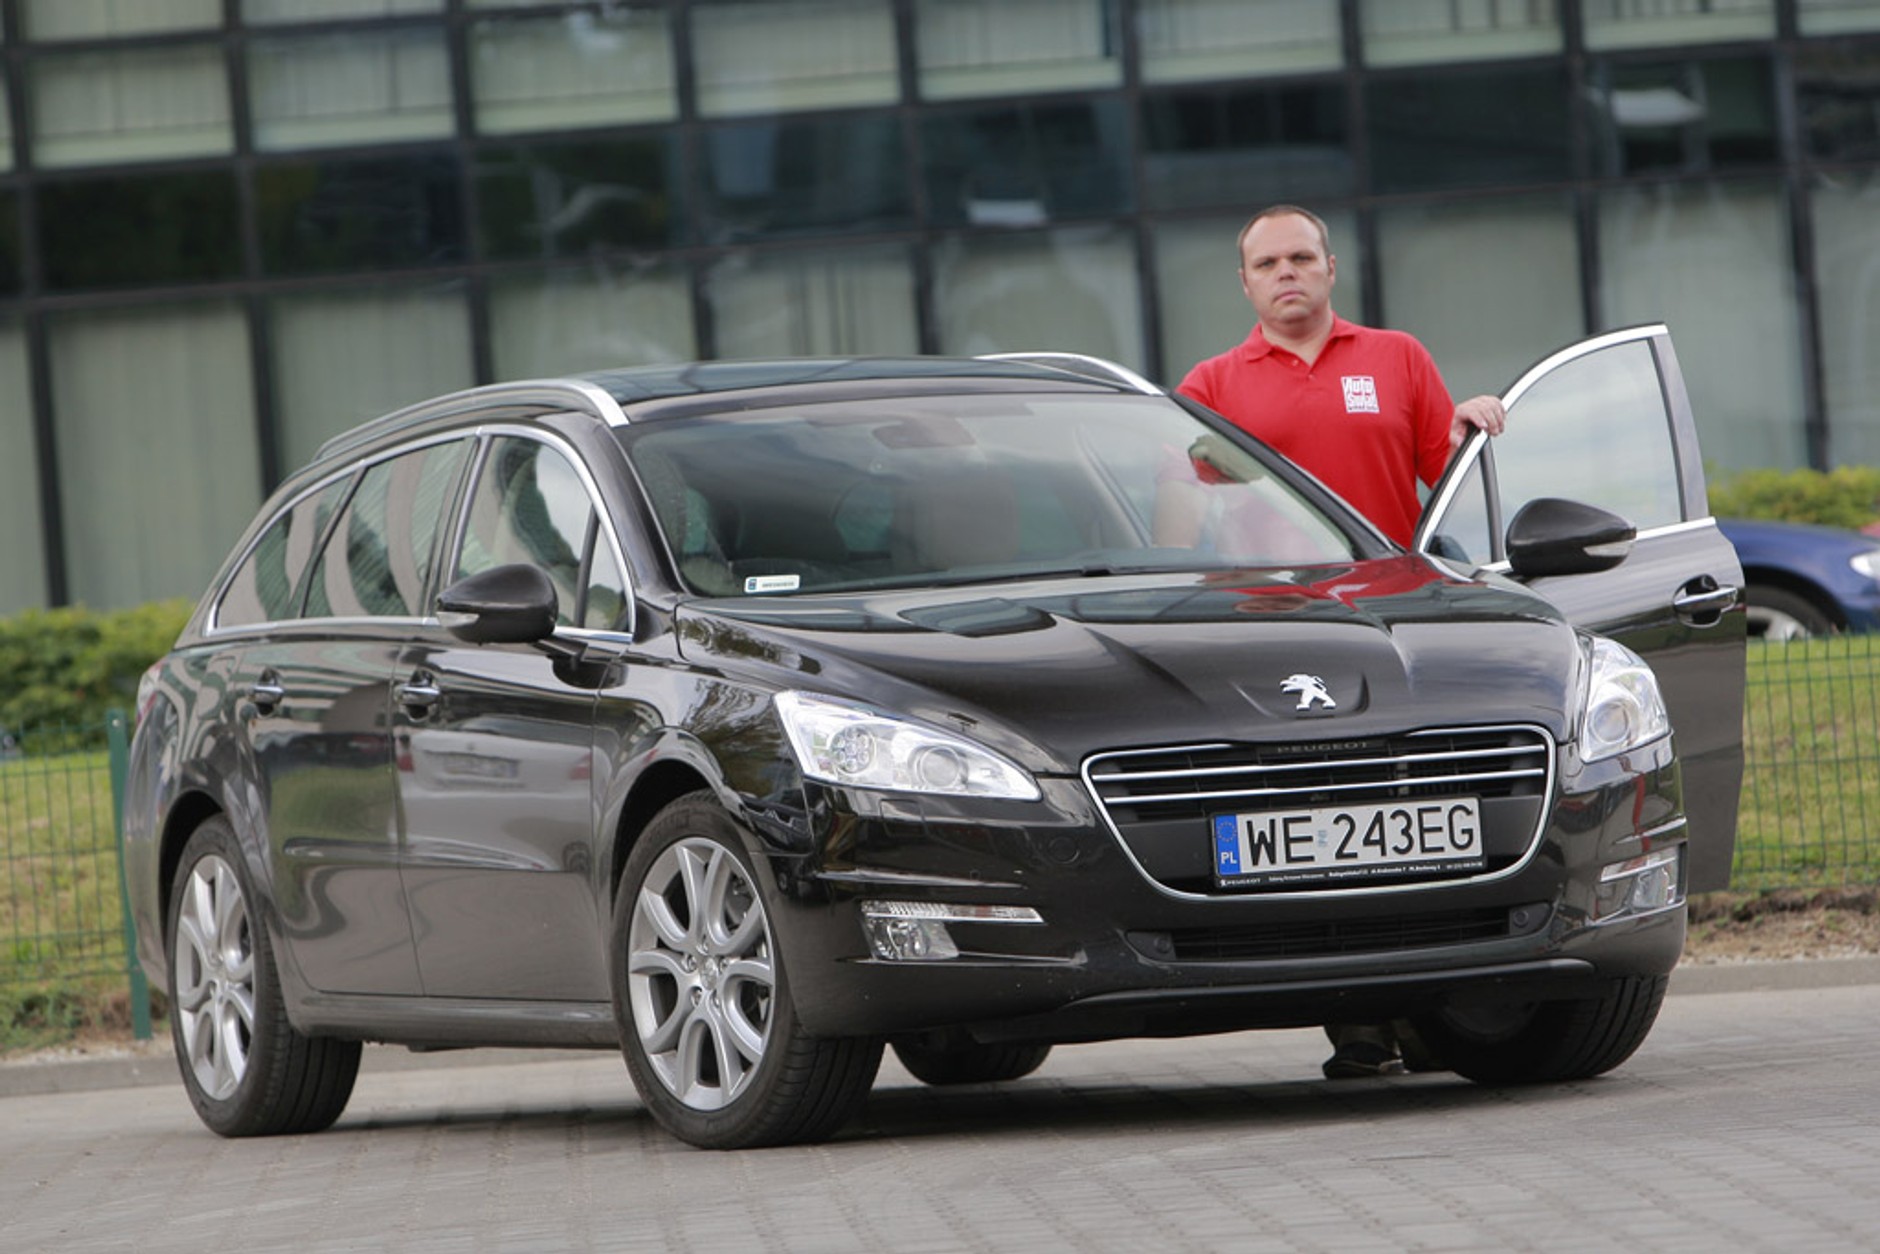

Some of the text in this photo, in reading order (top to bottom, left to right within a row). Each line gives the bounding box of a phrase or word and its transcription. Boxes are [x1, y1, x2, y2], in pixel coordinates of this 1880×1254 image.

[1246, 804, 1475, 866] WE 243EG
[1220, 851, 1238, 865] PL
